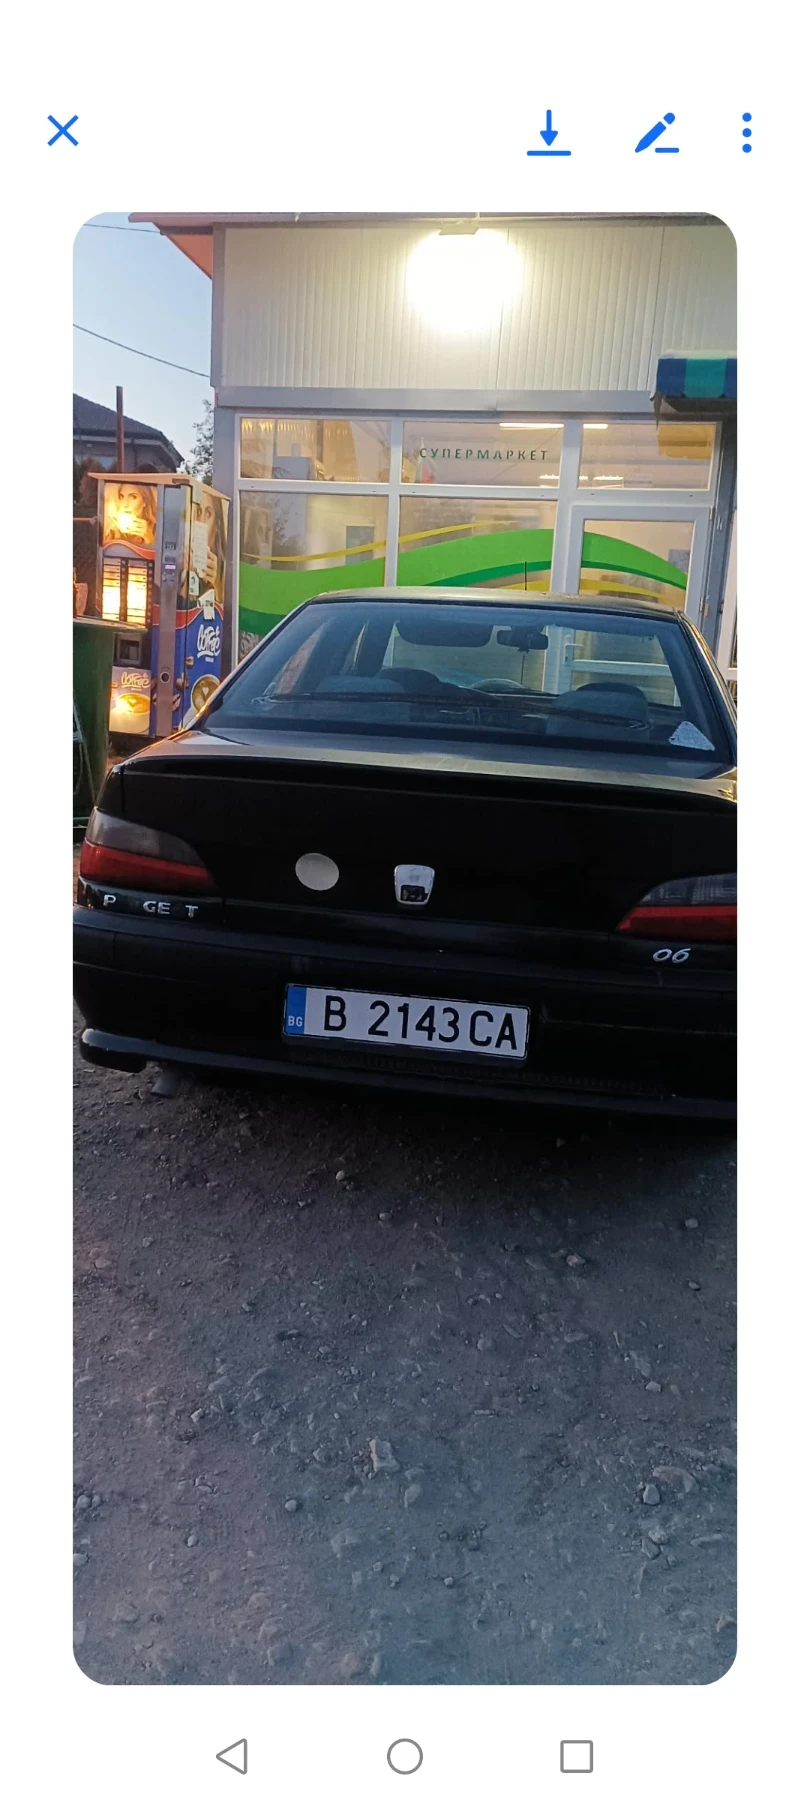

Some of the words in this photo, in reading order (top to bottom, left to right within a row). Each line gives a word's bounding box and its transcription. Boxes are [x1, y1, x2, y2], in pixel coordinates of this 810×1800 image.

[419, 447, 548, 461] СУПЕРМАРКЕТ
[652, 948, 691, 964] 06
[287, 1015, 303, 1027] BG
[323, 995, 347, 1031] B
[367, 1000, 460, 1043] 2143
[469, 1010, 518, 1050] CA
